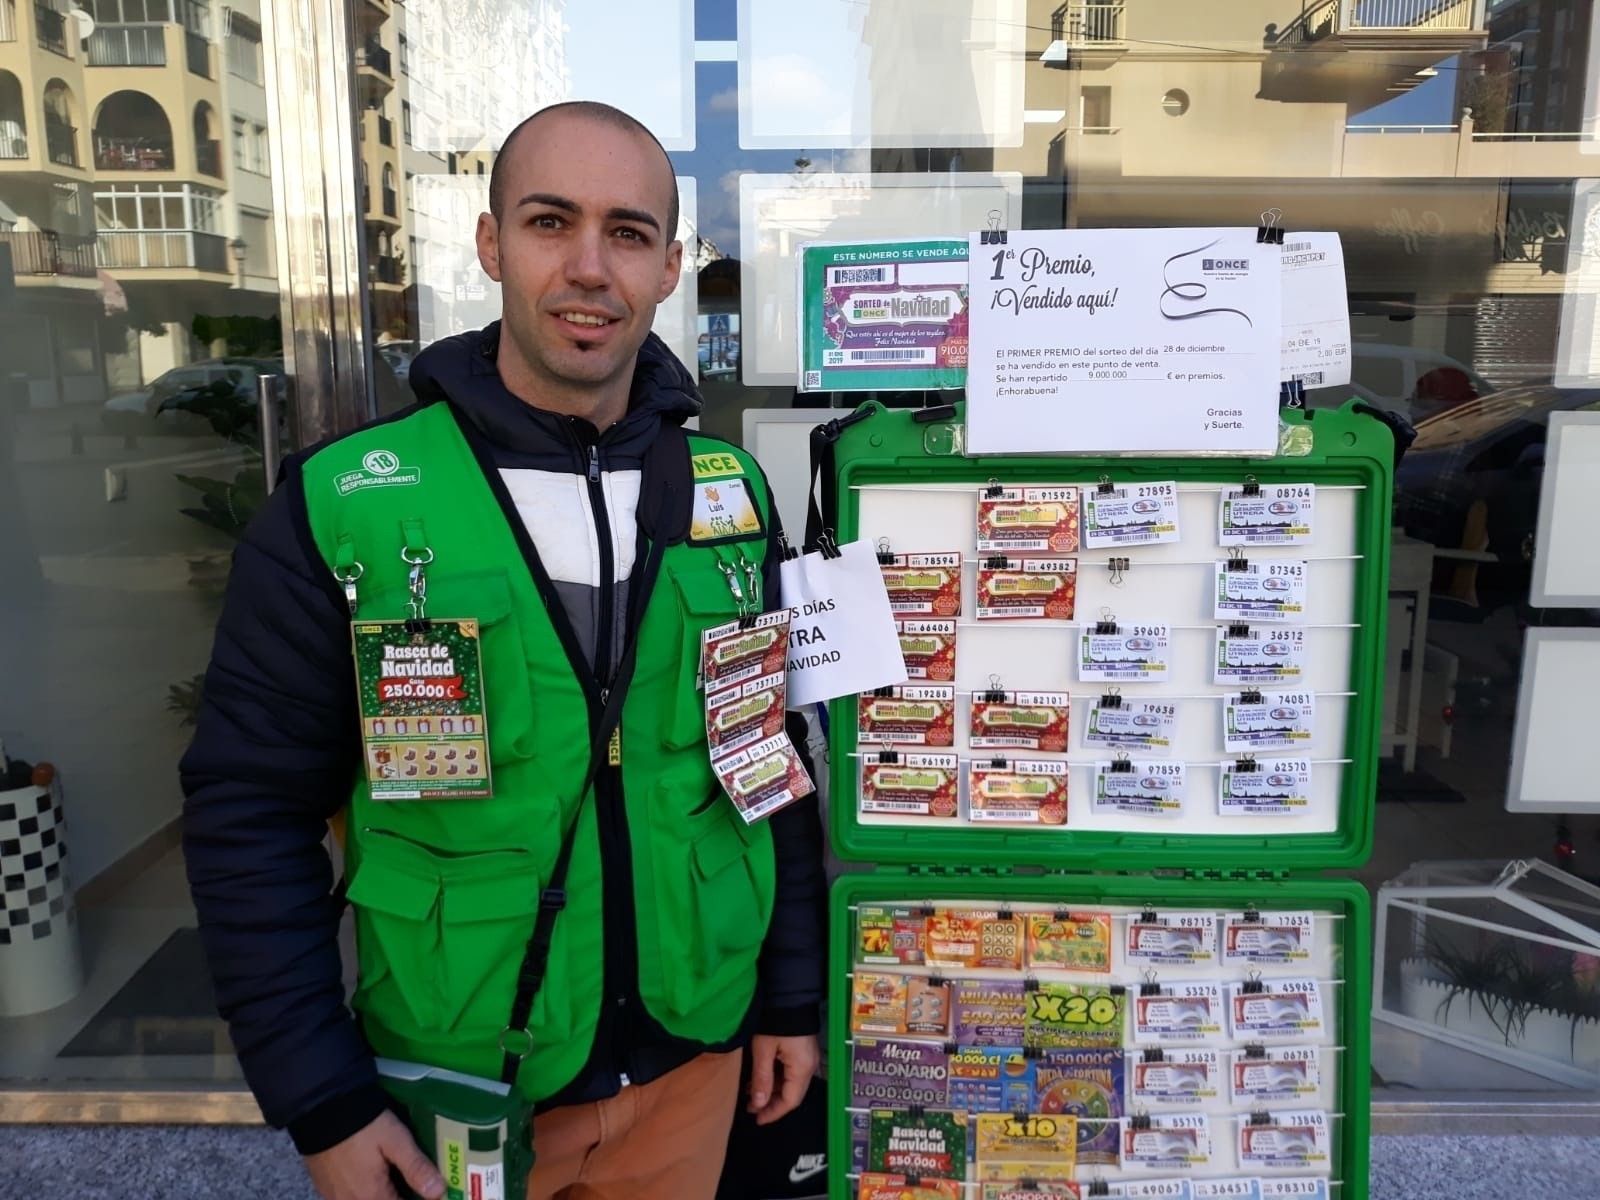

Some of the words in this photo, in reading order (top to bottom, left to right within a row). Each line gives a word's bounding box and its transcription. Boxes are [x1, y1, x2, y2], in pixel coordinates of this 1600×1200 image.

[833, 252, 857, 261] ESTE
[859, 249, 900, 260] NÚMERO
[902, 249, 914, 258] SE
[916, 248, 949, 258] VENDE
[1020, 247, 1096, 282] Premio,
[1215, 260, 1247, 269] ONCE
[990, 285, 1074, 316] ¡Vendido
[1076, 287, 1119, 316] aquí!
[853, 299, 881, 309] SORTEO
[891, 295, 950, 318] Navidad
[862, 309, 886, 317] ONCE
[996, 350, 1005, 358] El
[1007, 349, 1041, 357] PRIMER
[1044, 348, 1080, 357] PREMIO
[1083, 347, 1097, 356] del
[1099, 348, 1127, 356] sorteo
[1129, 347, 1143, 356] del
[1145, 347, 1159, 355] día
[1163, 345, 1174, 353] 28
[1175, 345, 1185, 353] de
[1187, 345, 1225, 353] diciembre
[828, 357, 844, 365] 2019
[996, 363, 1006, 371] se
[1008, 362, 1019, 370] ha
[1021, 361, 1056, 370] vendido
[1093, 361, 1119, 371] punto
[1121, 360, 1132, 368] de
[996, 374, 1007, 383] Se
[1009, 374, 1025, 383] han
[1027, 373, 1068, 384] repartido
[1167, 372, 1173, 380] €
[1188, 371, 1226, 382] premios.
[995, 386, 1059, 397] ¡Enhorabuena!
[1207, 408, 1243, 417] Gracias
[1204, 422, 1210, 430] y
[1211, 420, 1245, 429] Suerte.
[693, 456, 736, 473] NCE
[340, 472, 364, 485] JUEGA
[340, 475, 417, 493] RESPONSABLEMENTE
[1041, 491, 1071, 500] 91592
[1138, 485, 1172, 497] 27895
[1277, 487, 1310, 499] 08764
[708, 503, 725, 513] Luis
[924, 557, 954, 565] 78594
[1040, 563, 1070, 571] 49382
[1269, 565, 1302, 576] 87343
[792, 606, 800, 619] S
[803, 598, 836, 617] DÍAS
[758, 614, 784, 627] 73711
[920, 624, 949, 632] 66406
[1133, 626, 1166, 637] 59607
[788, 625, 826, 649] TRA
[1270, 631, 1303, 641] 36512
[384, 645, 429, 659] Rasca
[431, 643, 449, 659] de
[787, 650, 841, 672] AVIDAD
[381, 658, 455, 677] Navidad
[756, 675, 779, 690] 73711
[383, 684, 445, 698] 250.000
[447, 685, 455, 698] €
[918, 690, 947, 699] 19288
[1278, 694, 1310, 705] 74081
[761, 737, 784, 753] 73711
[922, 758, 951, 766] 96199
[1274, 761, 1307, 772] 62570
[1031, 764, 1061, 772] 28720
[1148, 765, 1181, 776] 97859
[1180, 918, 1212, 927] 98715
[1279, 917, 1310, 926] 17634
[1185, 986, 1217, 996] 53276
[1282, 982, 1315, 992] 45962
[959, 991, 1027, 1006] MILLONA
[1032, 994, 1118, 1025] X20
[882, 1043, 921, 1063] Mega
[1185, 1053, 1216, 1063] 35628
[1283, 1050, 1315, 1060] 06781
[854, 1060, 946, 1080] MILLONARIO
[892, 1126, 928, 1139] Rasca
[928, 1128, 943, 1139] de
[888, 1138, 946, 1153] Navidad
[448, 1144, 460, 1185] ONCE
[796, 1153, 826, 1170] NIKE
[1141, 1183, 1181, 1195] 49067
[1211, 1183, 1249, 1194] 36451
[1277, 1182, 1315, 1193] 98310
